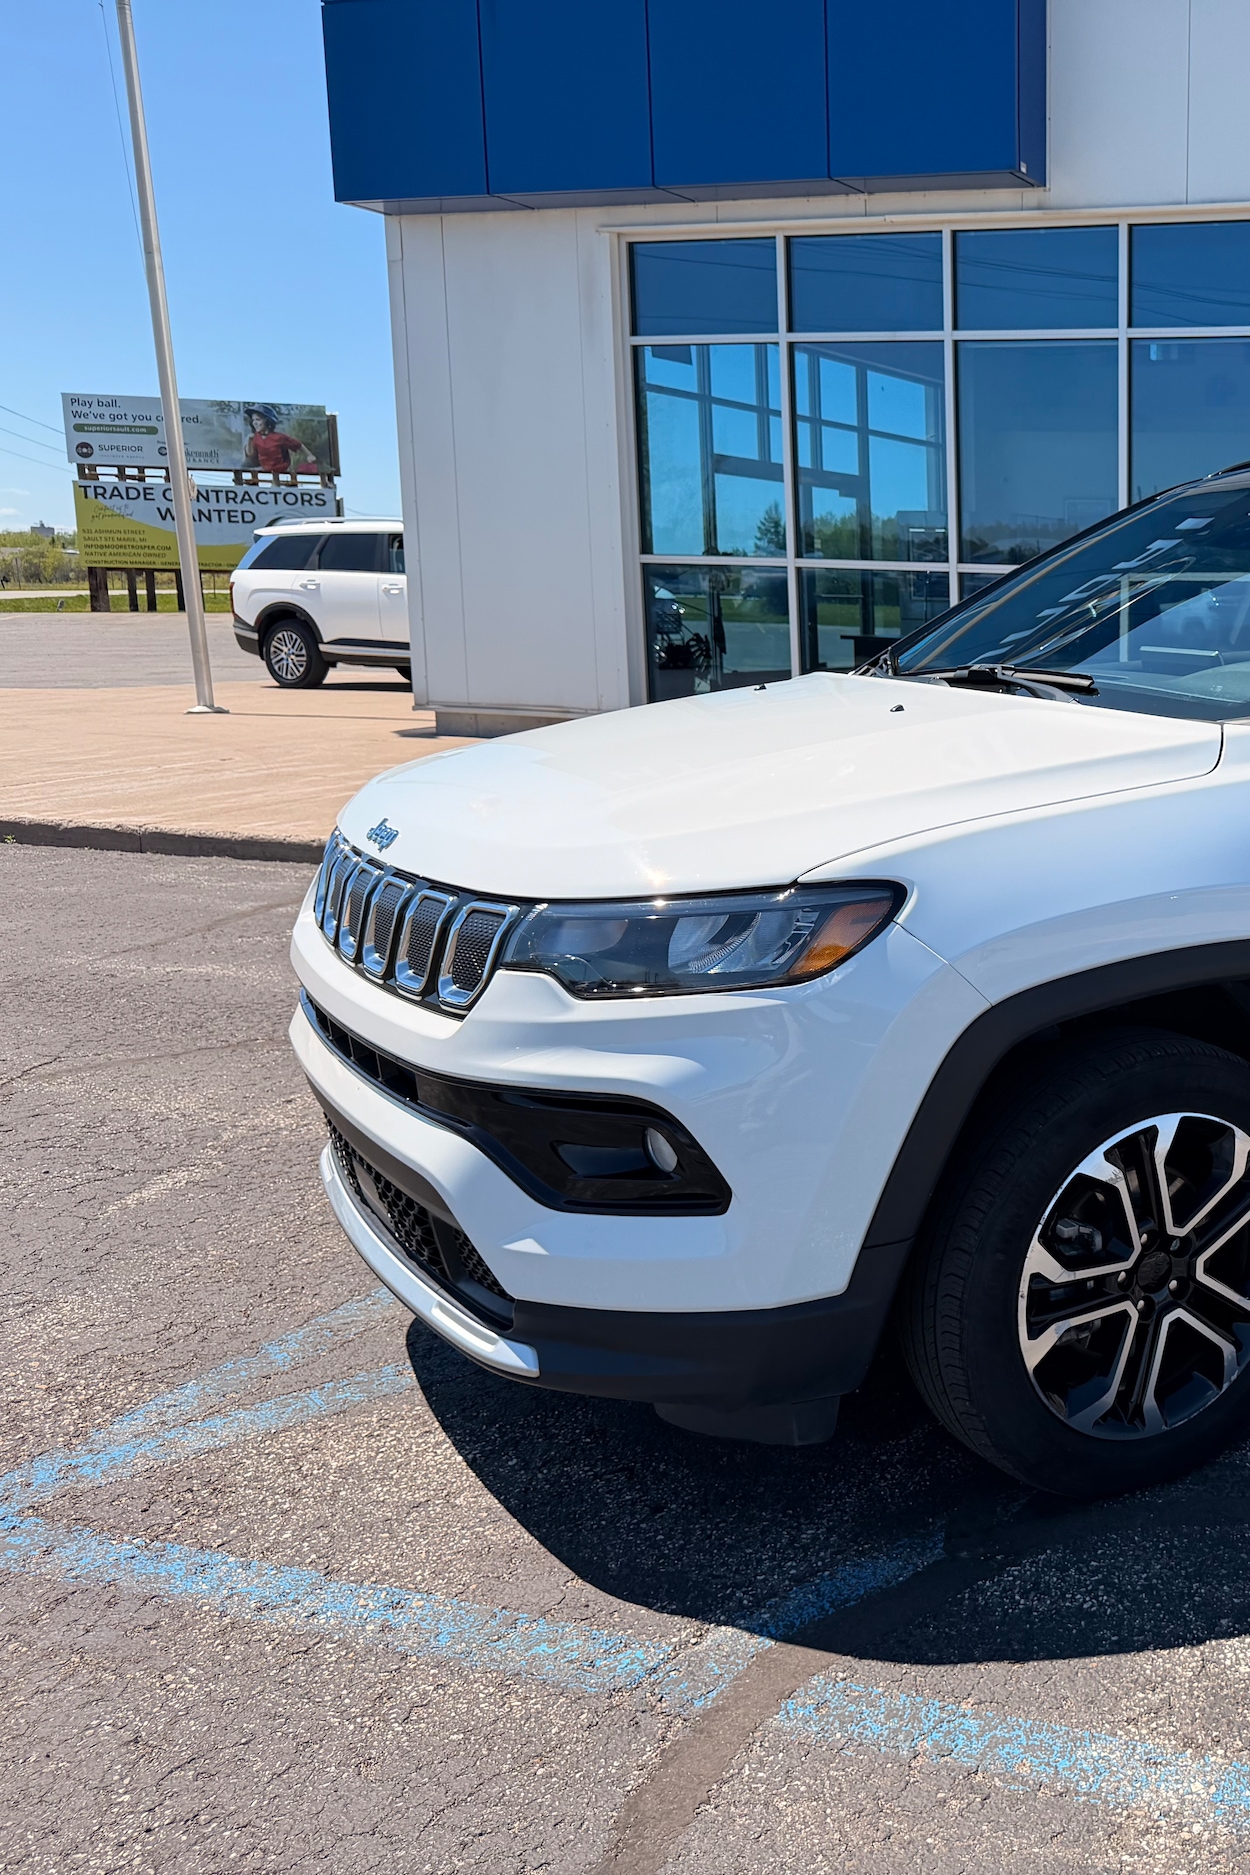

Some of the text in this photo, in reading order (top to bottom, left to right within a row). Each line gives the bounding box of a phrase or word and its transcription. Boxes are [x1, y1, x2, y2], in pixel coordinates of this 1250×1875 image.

[70, 397, 121, 409] Play ball.
[71, 410, 203, 424] We've got you cred.
[84, 425, 147, 433] superiorsault.com
[98, 444, 143, 453] SUPERIOR
[78, 485, 327, 507] TRADE CNTRACTORS
[156, 507, 256, 525] WNTED
[366, 817, 400, 853] Jeep
